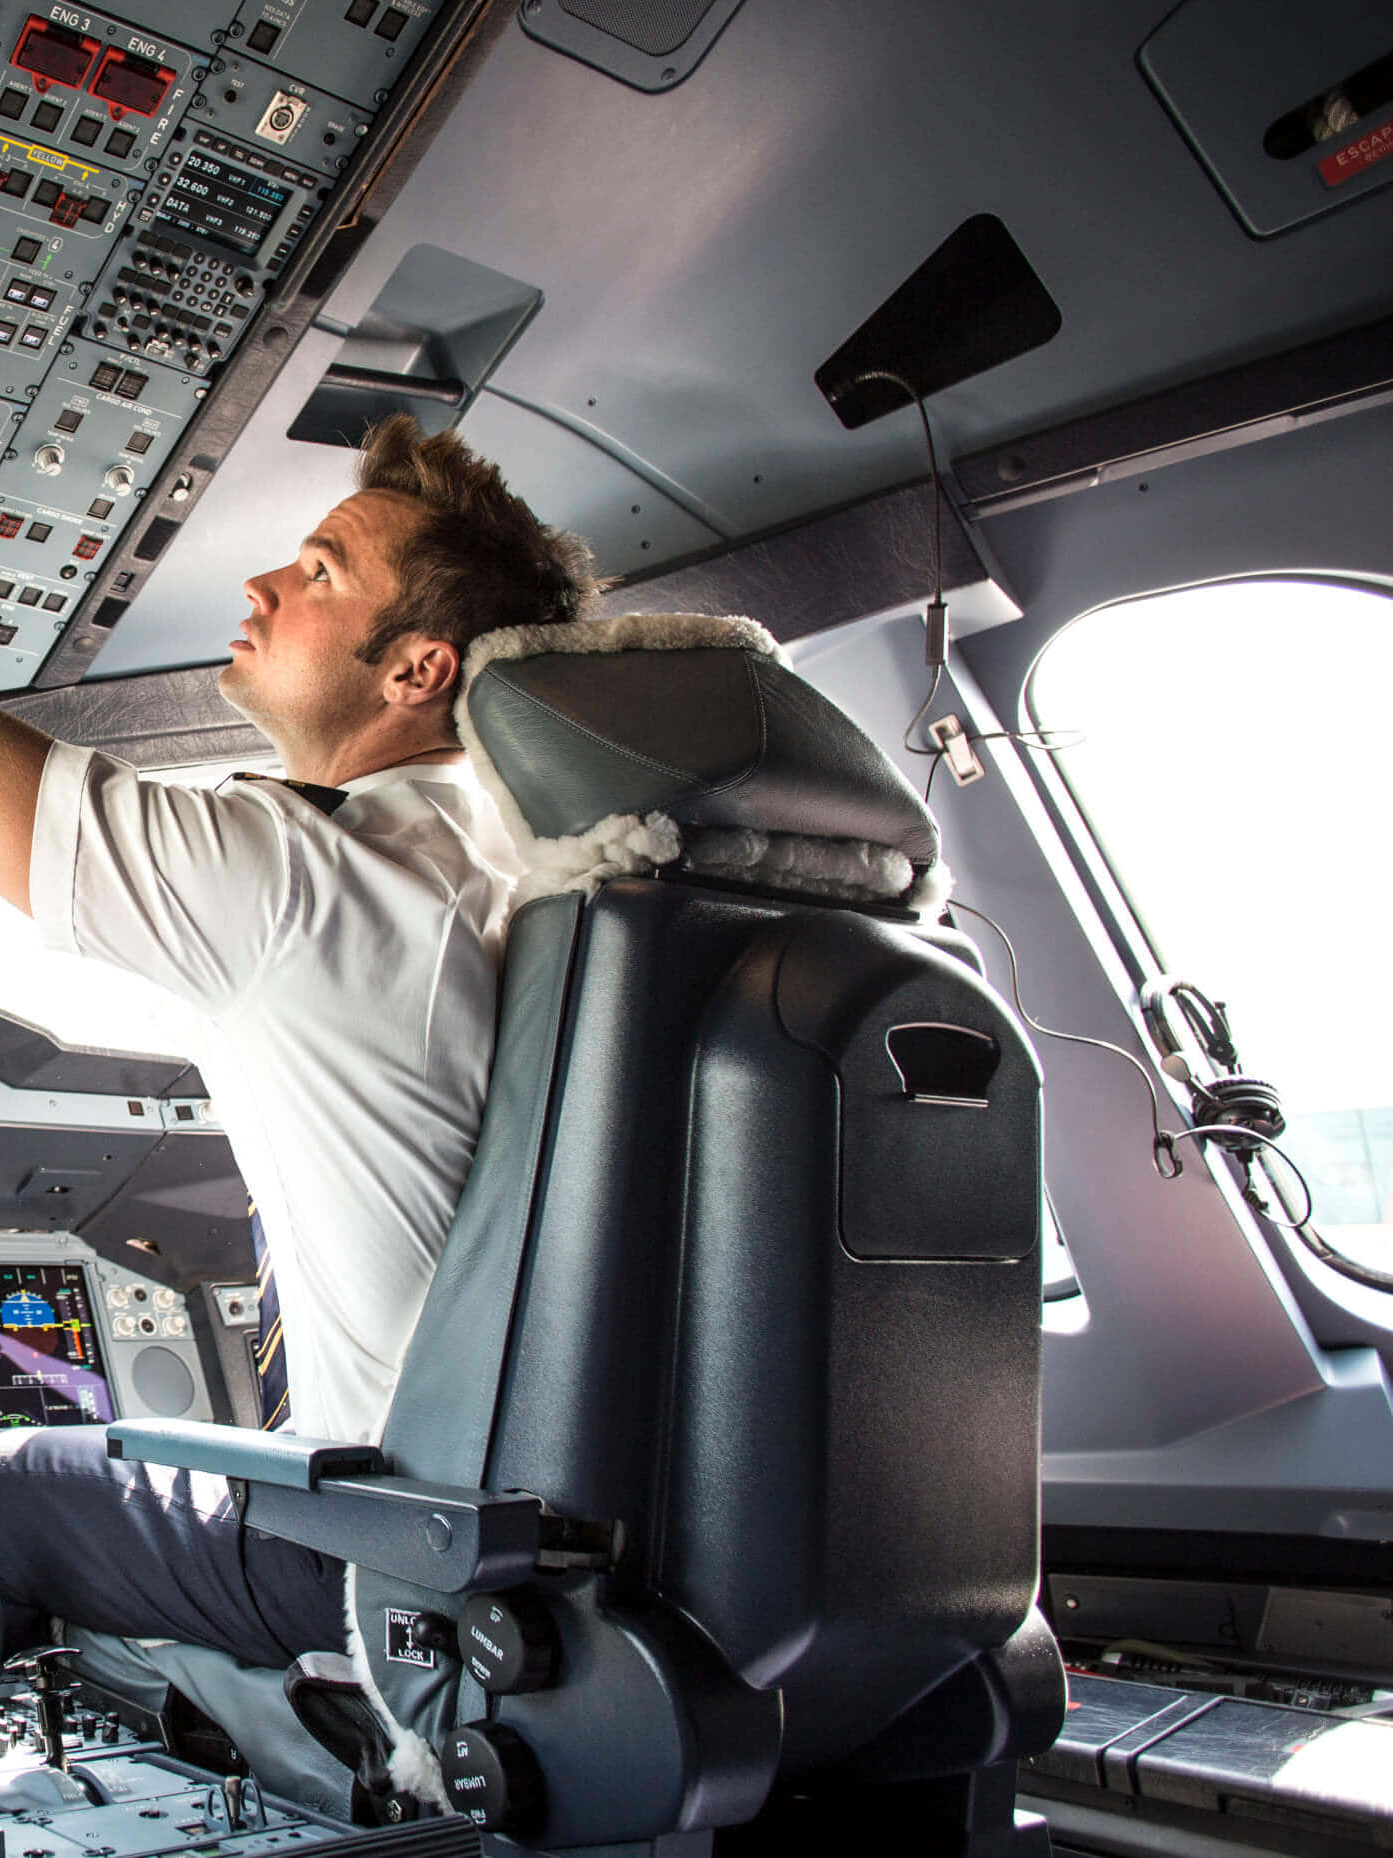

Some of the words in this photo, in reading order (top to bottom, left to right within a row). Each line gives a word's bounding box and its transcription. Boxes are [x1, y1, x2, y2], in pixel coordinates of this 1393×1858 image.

[50, 5, 79, 26] ENG
[80, 18, 91, 32] 3
[127, 36, 157, 57] ENG
[156, 48, 167, 62] 4
[289, 83, 306, 96] CVR
[150, 88, 184, 145] FIRE
[31, 148, 65, 166] YELLOW
[105, 201, 127, 233] HYD
[51, 239, 60, 251] 4
[48, 305, 74, 345] FUEL
[96, 394, 121, 407] CARGO
[122, 400, 133, 409] AIR
[133, 403, 152, 415] COND
[37, 508, 59, 519] CARGO
[470, 1625, 504, 1661] LUMBAR
[398, 1649, 424, 1661] LOCK
